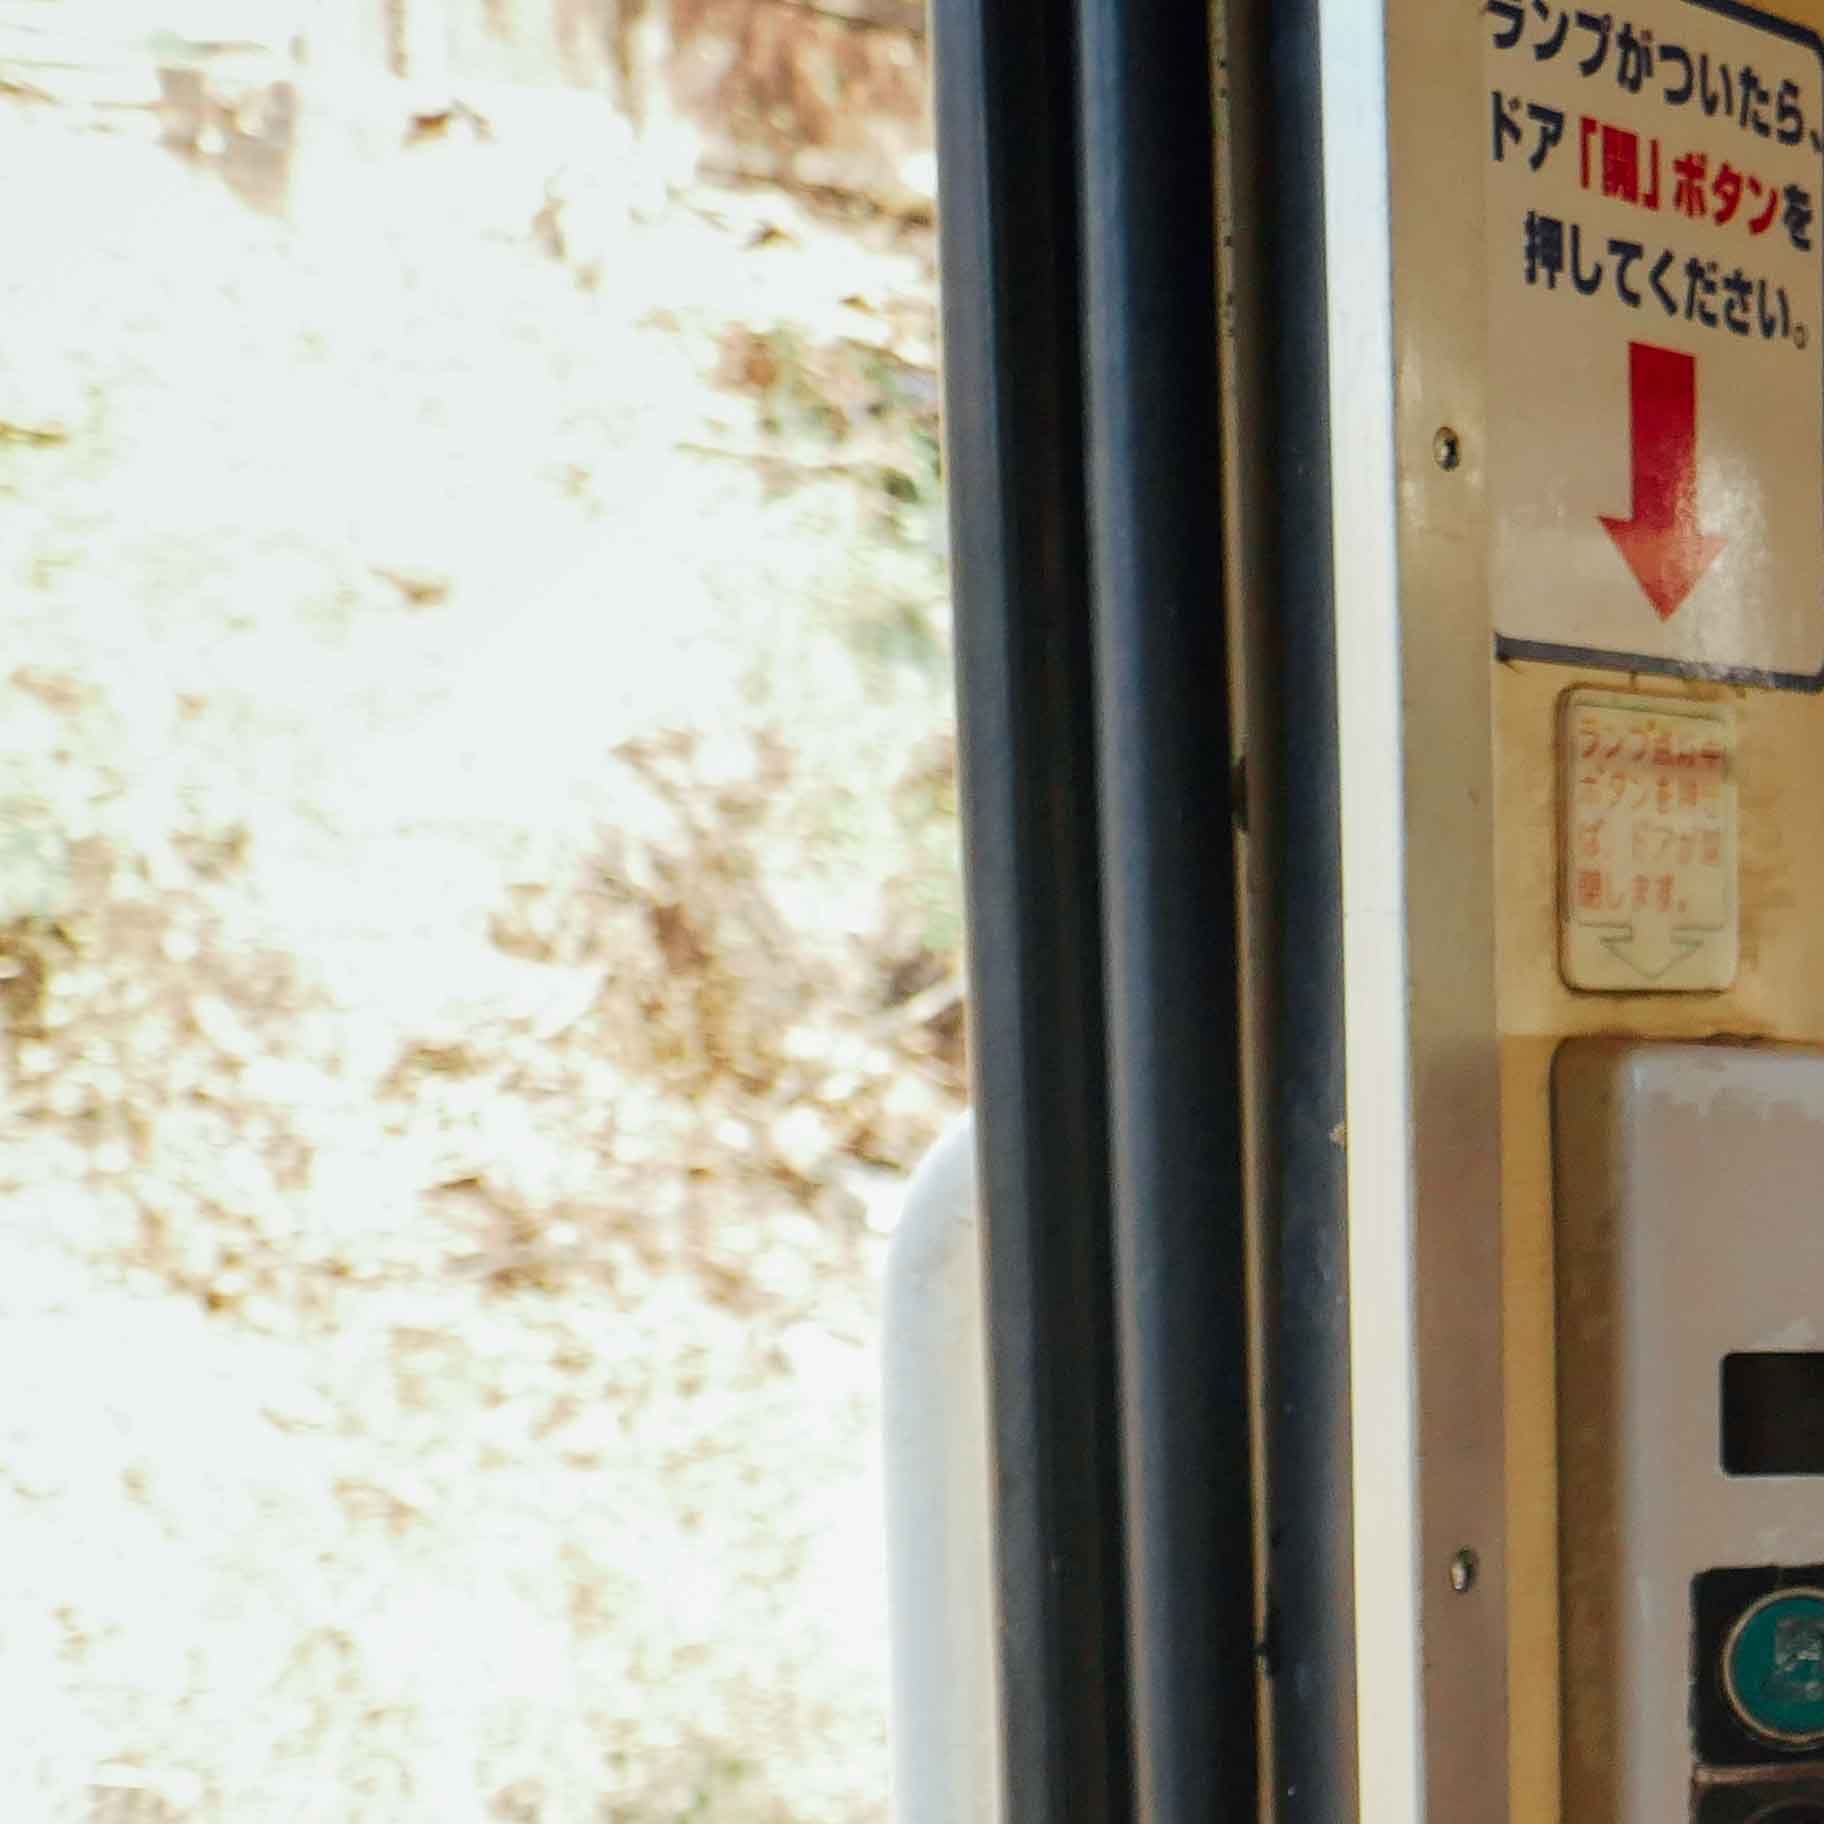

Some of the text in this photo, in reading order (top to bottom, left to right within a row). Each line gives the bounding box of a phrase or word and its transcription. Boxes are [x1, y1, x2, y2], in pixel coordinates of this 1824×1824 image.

[1523, 209, 1807, 349] 押してください。
